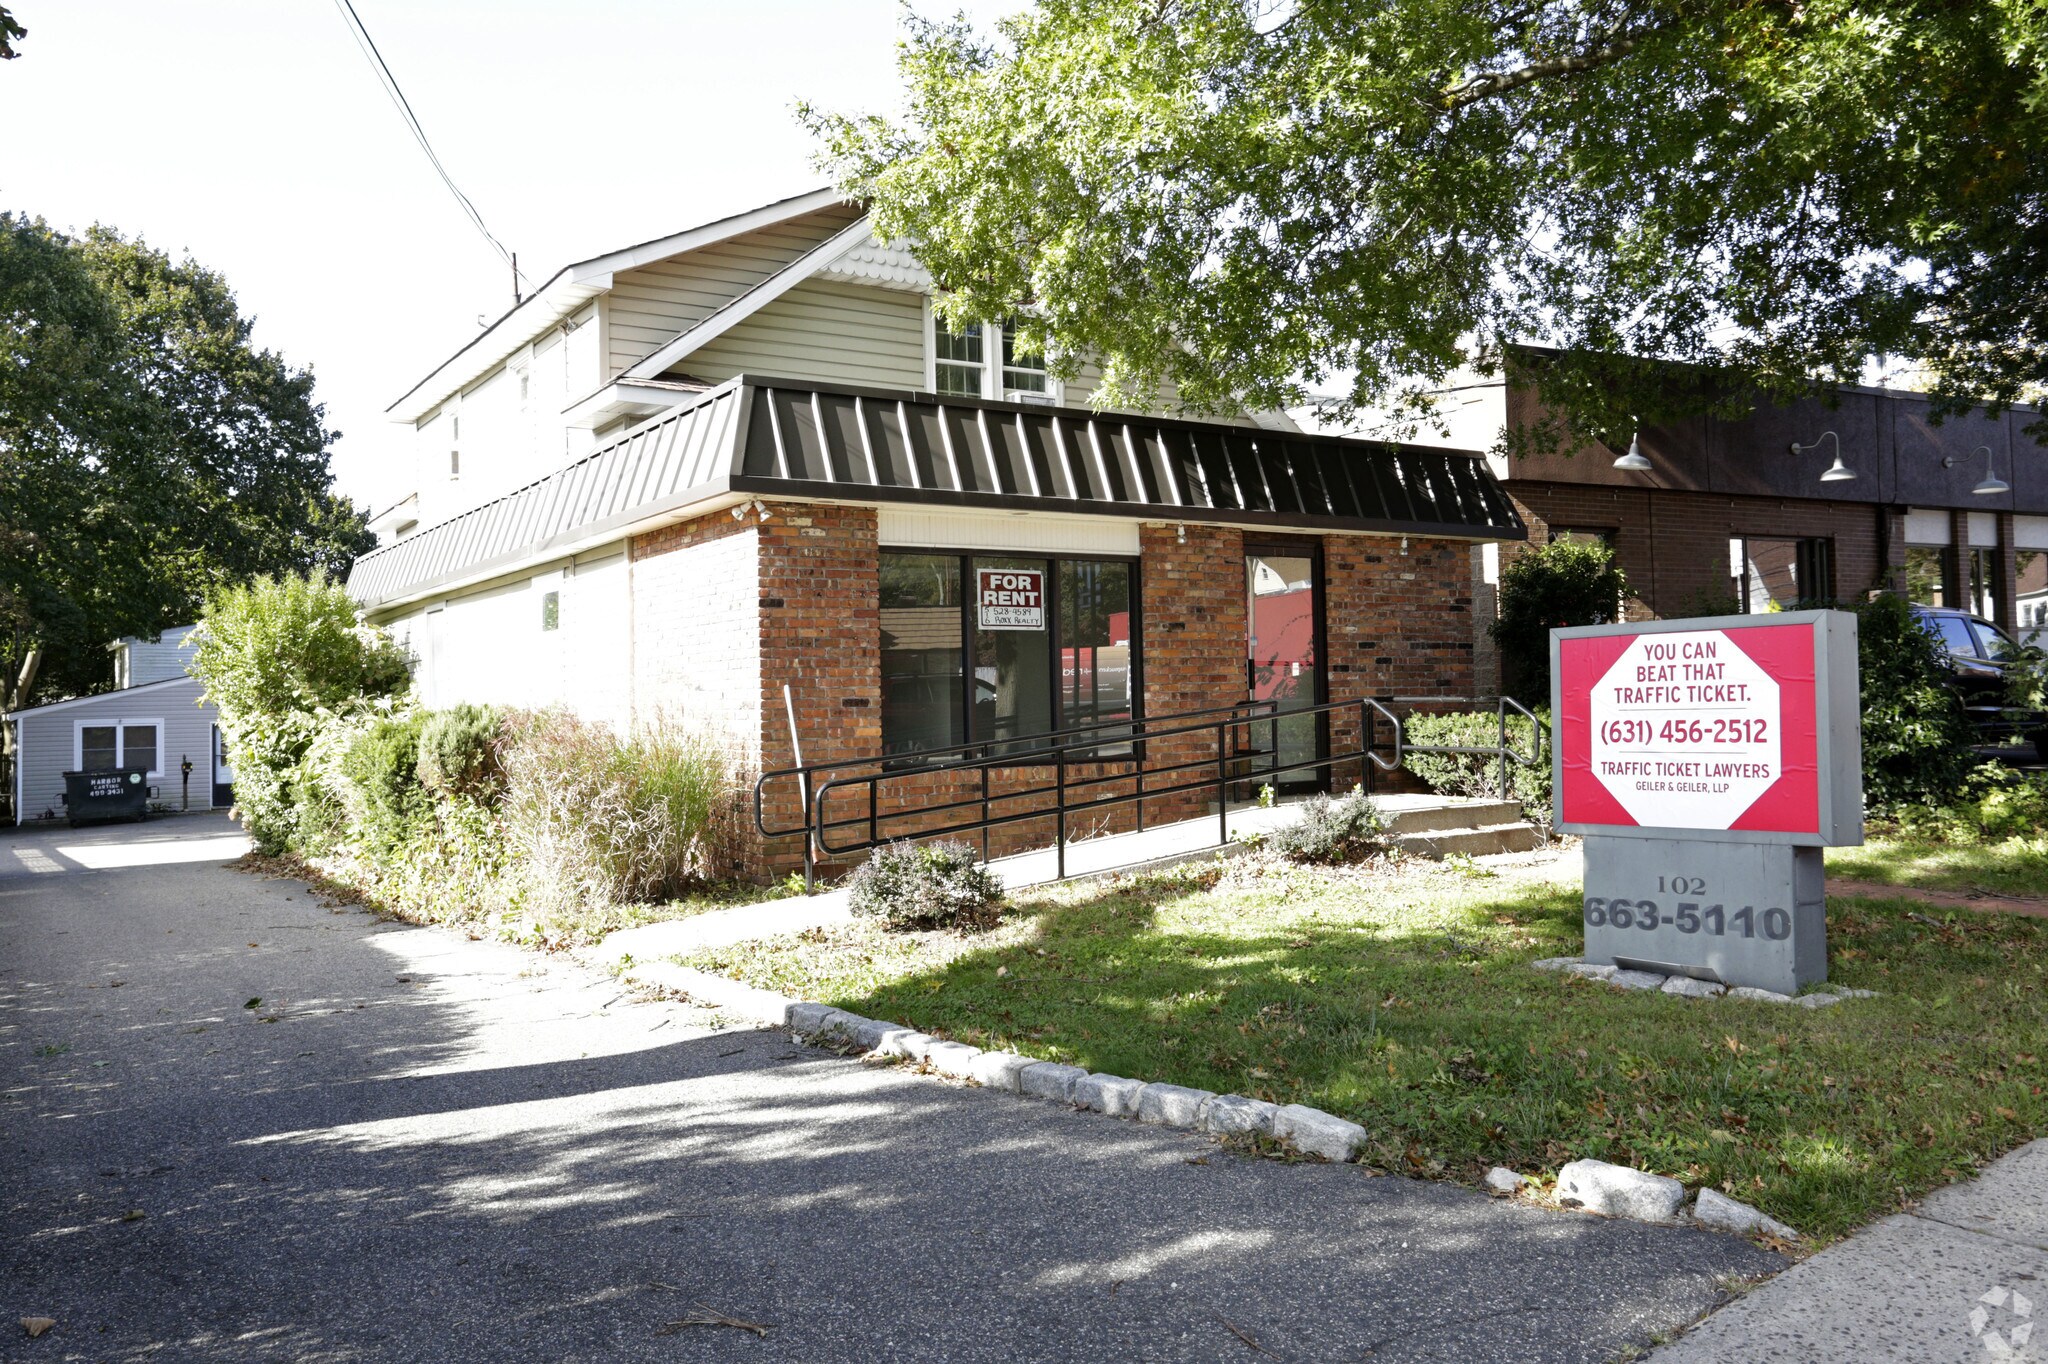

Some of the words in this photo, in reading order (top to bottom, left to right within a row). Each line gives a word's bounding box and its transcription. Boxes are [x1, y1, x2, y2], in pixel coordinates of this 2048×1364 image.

[990, 575, 1032, 590] FOR
[983, 590, 1038, 606] RENT
[1644, 643, 1677, 661] YOU
[1682, 641, 1717, 660] CAN
[1637, 665, 1676, 683] BEAT
[1684, 663, 1726, 681] THAT
[1614, 685, 1681, 704] TRAFFIC
[1688, 684, 1751, 702] TICKET.
[1600, 720, 1652, 746] (631)
[1659, 718, 1768, 744] 456-2512
[1601, 761, 1651, 776] TRAFFIC
[1655, 763, 1701, 777] TICKET
[1705, 763, 1770, 779] LAWYERS
[90, 777, 122, 785] HARBOR
[1635, 781, 1666, 792] GEILER
[1668, 782, 1674, 792] &
[1676, 782, 1710, 793] GEILER,
[1713, 783, 1730, 793] LLP
[1657, 875, 1706, 896] 102
